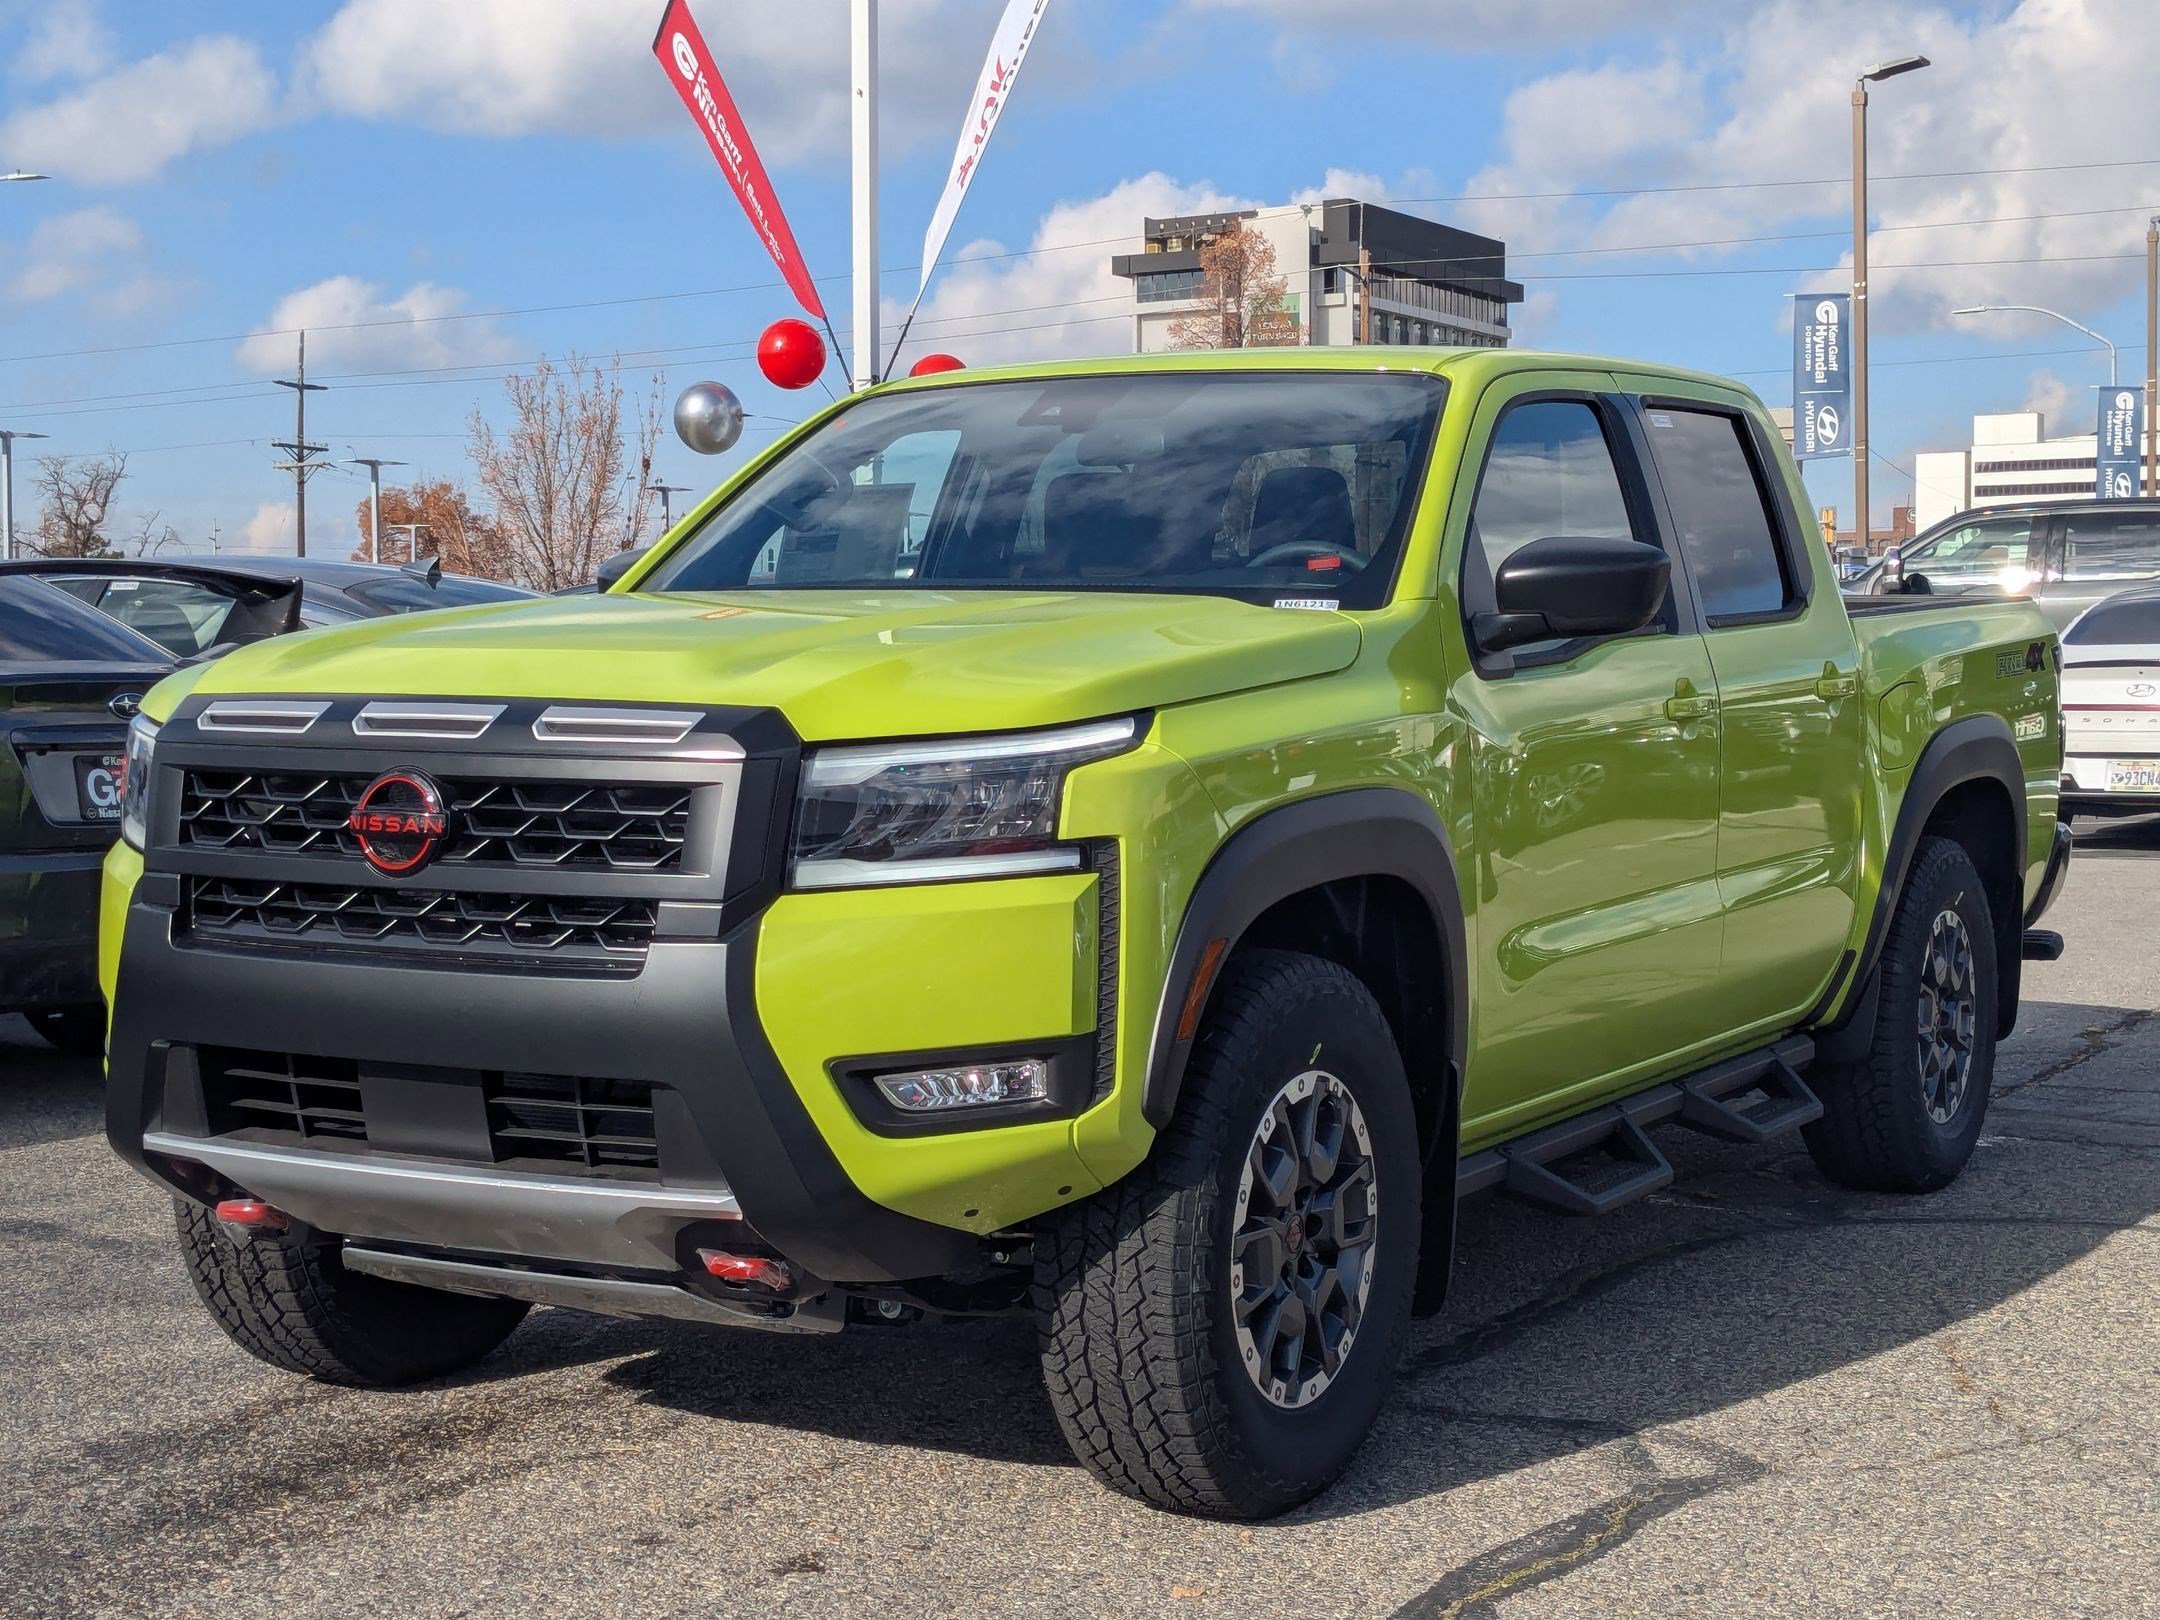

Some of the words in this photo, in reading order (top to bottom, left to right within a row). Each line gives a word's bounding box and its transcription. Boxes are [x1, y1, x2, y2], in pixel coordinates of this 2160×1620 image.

[697, 71, 717, 115] Ken
[693, 82, 742, 183] Nissan
[1828, 325, 1838, 345] Ken
[1813, 325, 1827, 384] Hyundai
[1828, 346, 1838, 371] Garff
[1805, 400, 1814, 453] HYUNDAI
[2113, 410, 2125, 455] Hyundai
[2125, 411, 2134, 426] Ken
[2125, 427, 2133, 447] Garff
[349, 815, 443, 833] NISSAN
